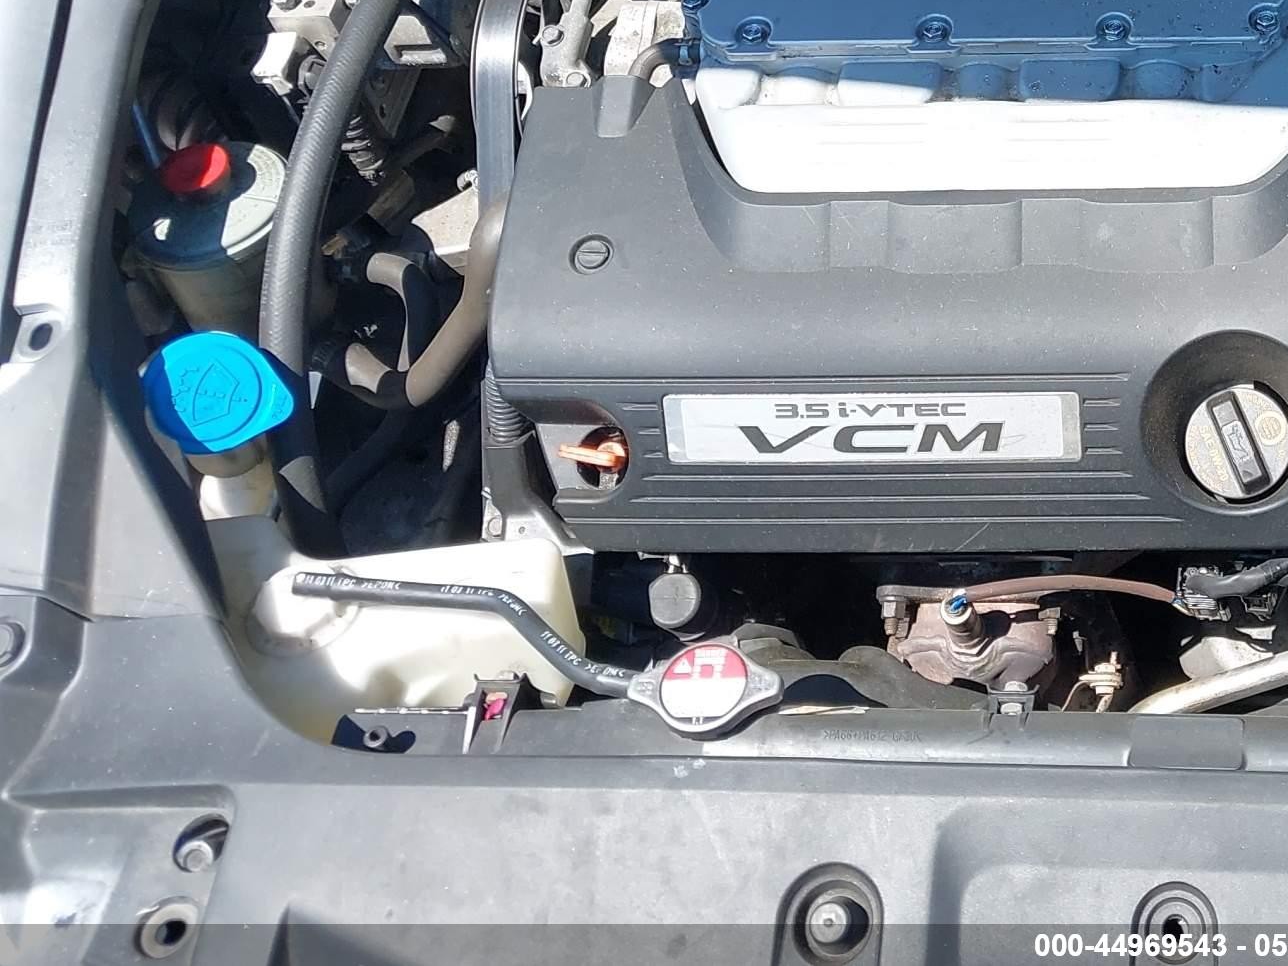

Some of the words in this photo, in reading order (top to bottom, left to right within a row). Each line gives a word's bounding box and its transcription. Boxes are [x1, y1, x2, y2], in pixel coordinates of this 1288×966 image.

[775, 403, 829, 419] 3.5
[838, 402, 967, 418] i-VTEC
[738, 422, 1004, 454] VCM
